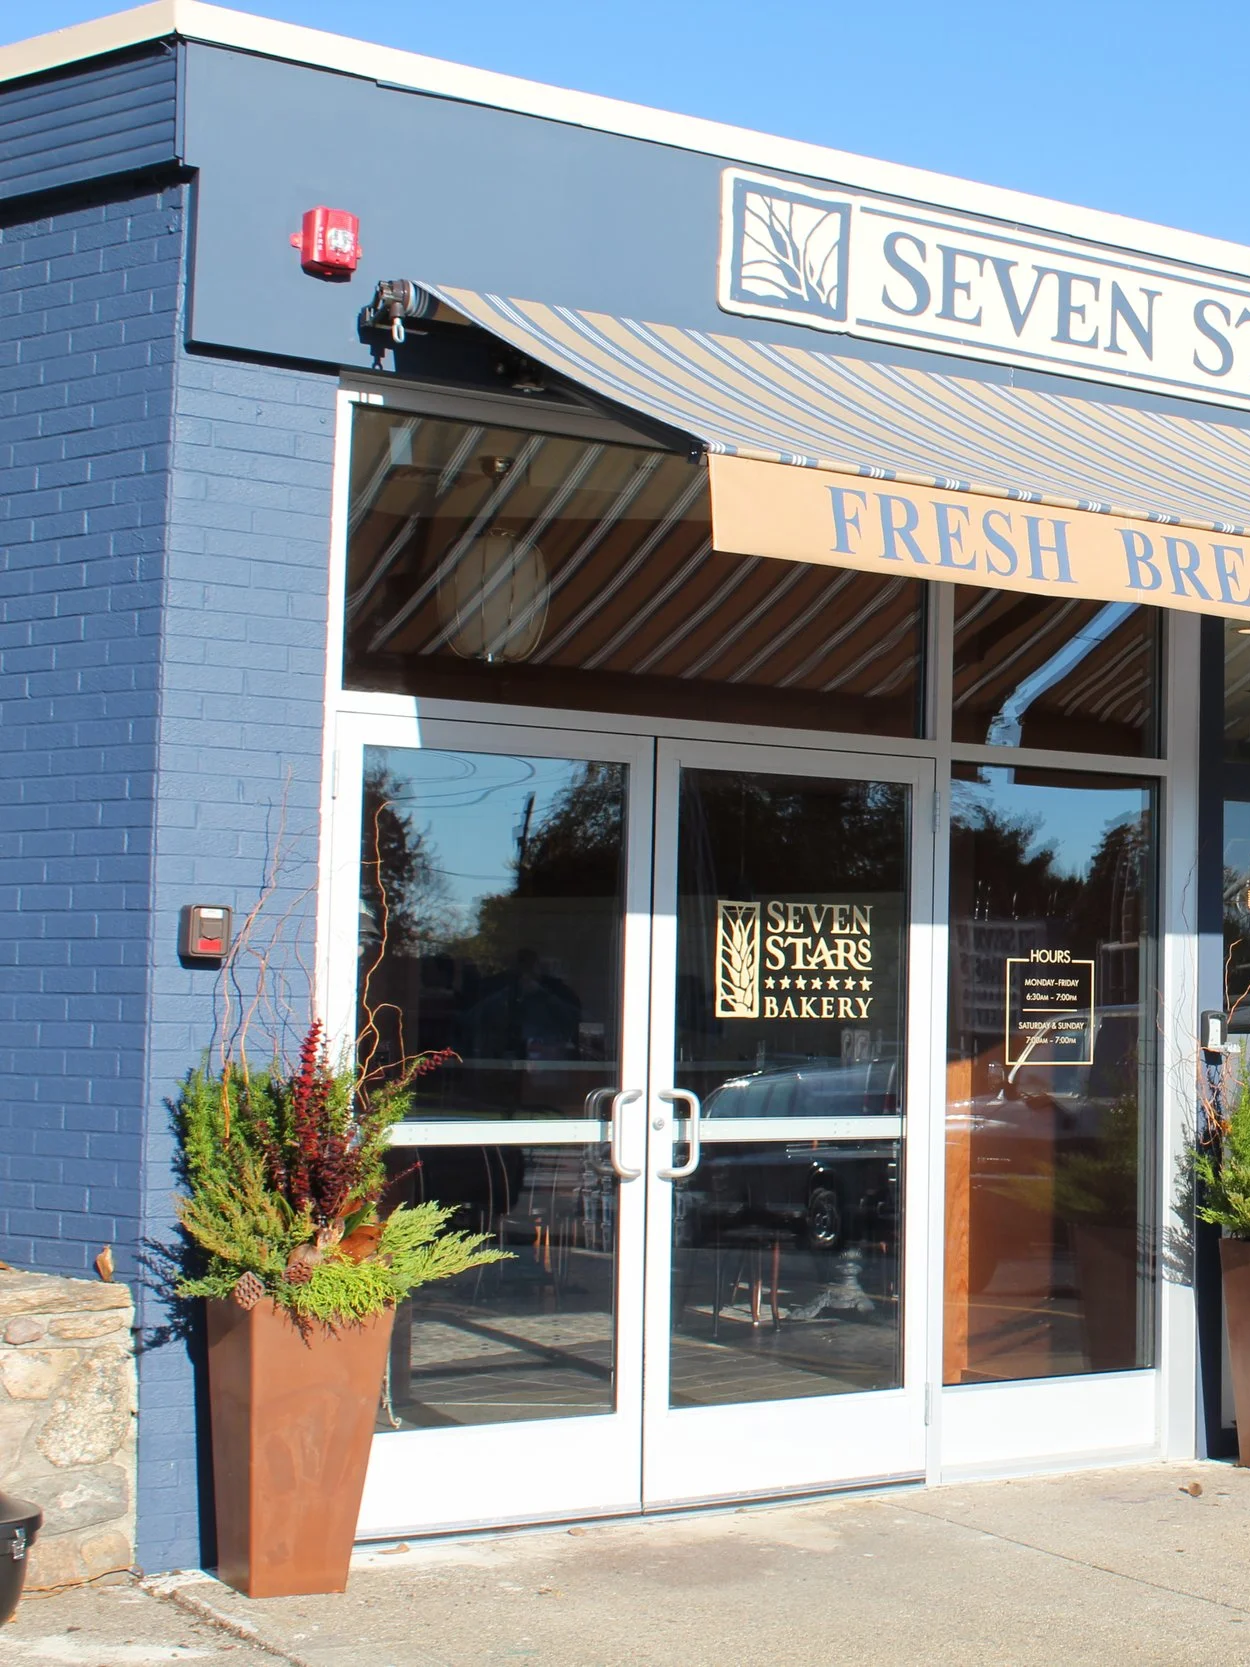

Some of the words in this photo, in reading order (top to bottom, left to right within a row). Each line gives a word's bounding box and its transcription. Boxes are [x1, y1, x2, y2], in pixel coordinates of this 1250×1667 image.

[880, 230, 1163, 361] SEVEN
[823, 485, 1079, 584] FRESH
[766, 900, 874, 936] SEVEN
[765, 935, 873, 971] STARS
[1030, 949, 1071, 964] HOURS
[763, 996, 874, 1019] BAKERY
[1026, 993, 1049, 1001] 6:30AM
[1056, 993, 1077, 1001] 7:00PM
[1018, 1021, 1051, 1030] SATURDAY
[1057, 1021, 1085, 1031] SUNDAY
[1055, 1036, 1077, 1044] 7:00PM
